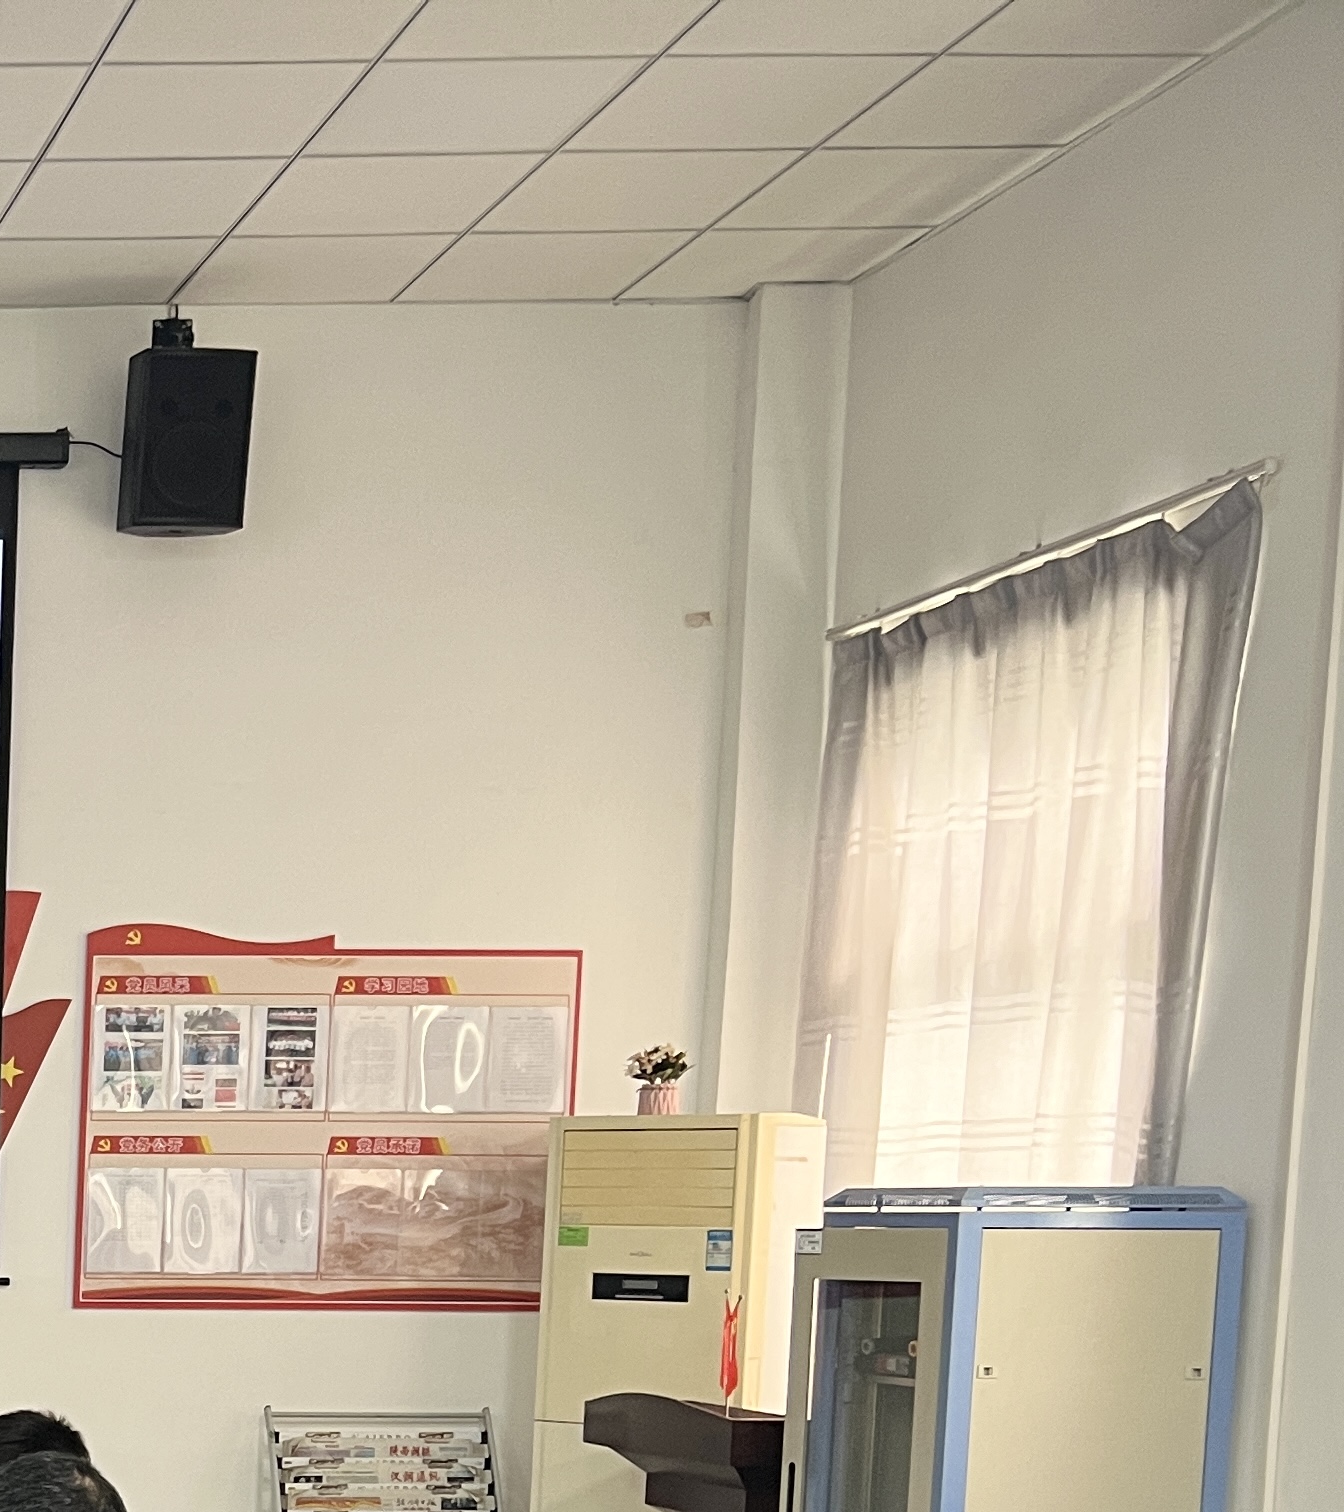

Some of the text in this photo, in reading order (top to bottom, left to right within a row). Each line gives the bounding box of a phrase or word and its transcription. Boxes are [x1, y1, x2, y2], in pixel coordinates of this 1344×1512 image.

[363, 977, 430, 994] 学习园地
[119, 1137, 184, 1153] 党务公开
